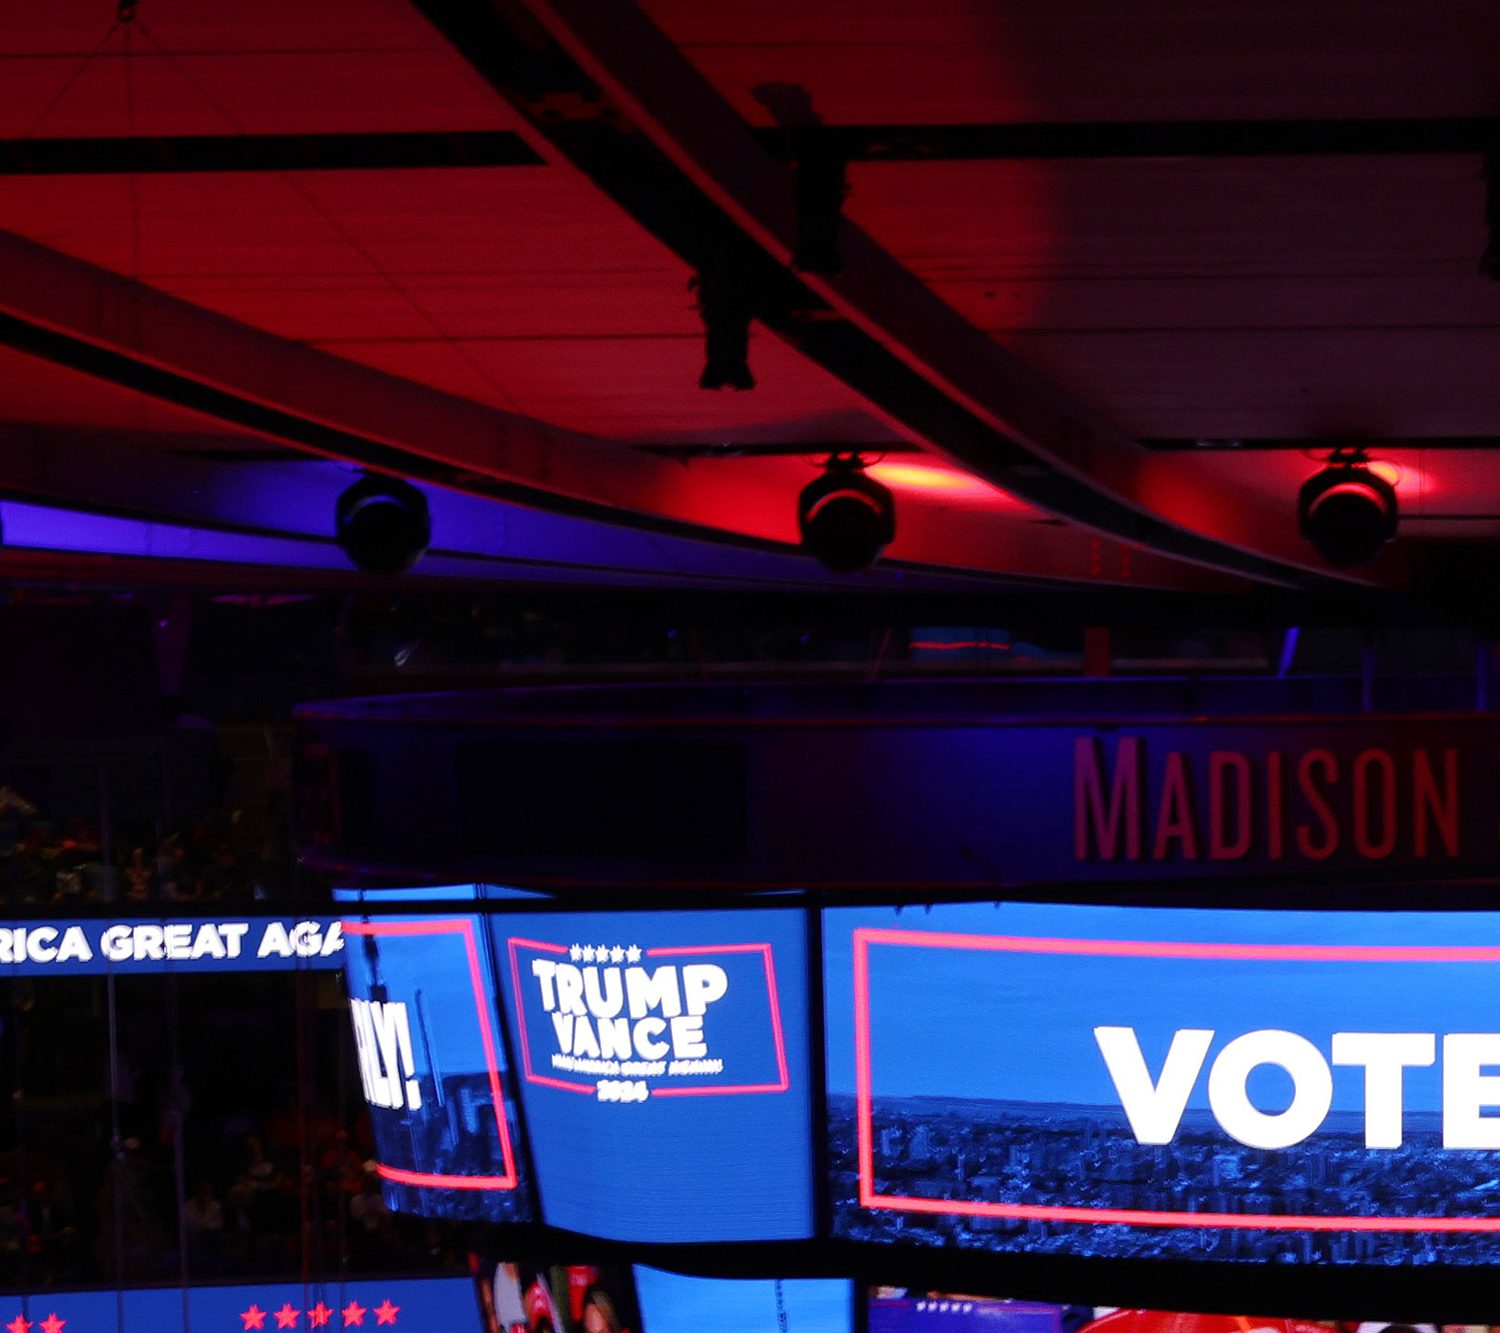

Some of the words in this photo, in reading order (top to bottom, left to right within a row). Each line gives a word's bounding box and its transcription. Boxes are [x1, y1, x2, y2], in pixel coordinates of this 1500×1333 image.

[1074, 736, 1460, 863] MADISON
[101, 923, 248, 961] GREAT
[532, 958, 728, 1019] TRUMP
[551, 1011, 708, 1060] VANCE
